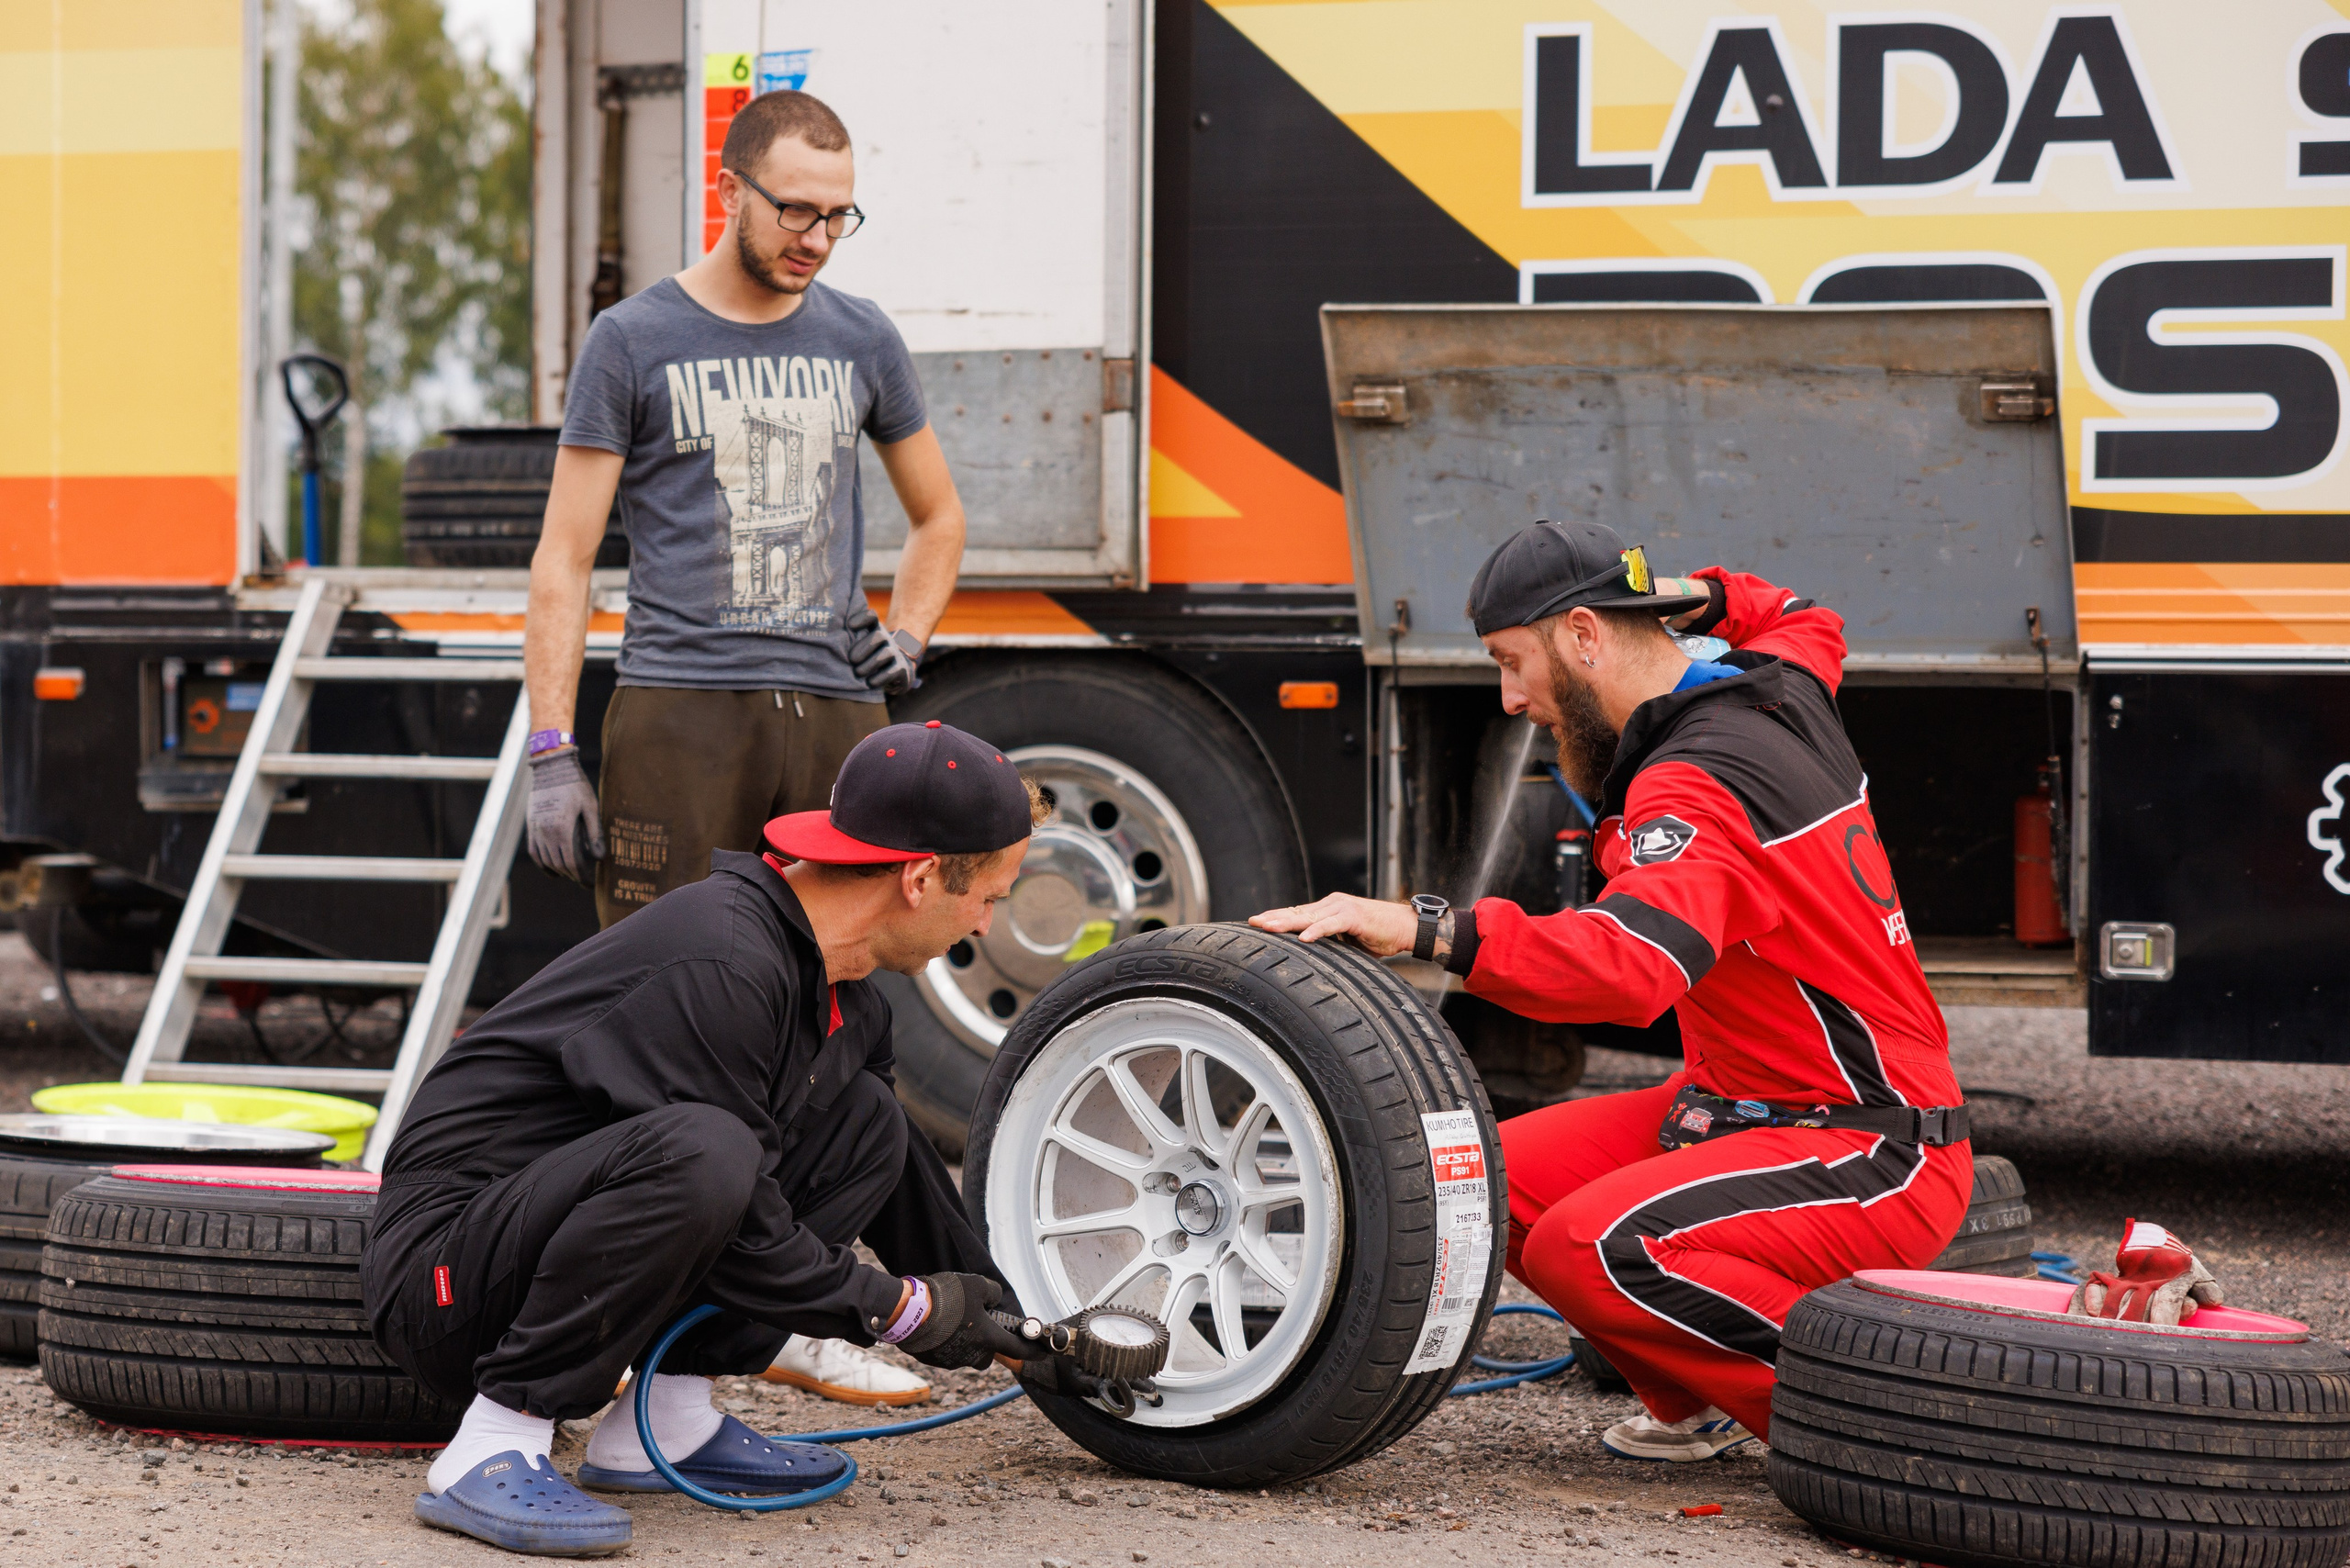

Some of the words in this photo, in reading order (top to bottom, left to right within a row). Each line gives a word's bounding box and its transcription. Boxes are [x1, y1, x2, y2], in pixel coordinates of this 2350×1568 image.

[732, 54, 749, 82] 6
[1529, 11, 2181, 199] LADA
[676, 438, 699, 454] CITY
[700, 436, 713, 451] OF
[719, 610, 769, 625] URBAN
[777, 610, 830, 624] CULTURE
[618, 879, 656, 892] GROWTH
[614, 888, 623, 899] IS
[625, 890, 632, 901] A
[1451, 1166, 1470, 1177] PS91
[1477, 1182, 1486, 1193] XL
[1433, 1267, 1441, 1288] ZR18
[1431, 1289, 1438, 1298] XL
[901, 1323, 913, 1336] TEAM
[912, 1306, 923, 1324] 2023
